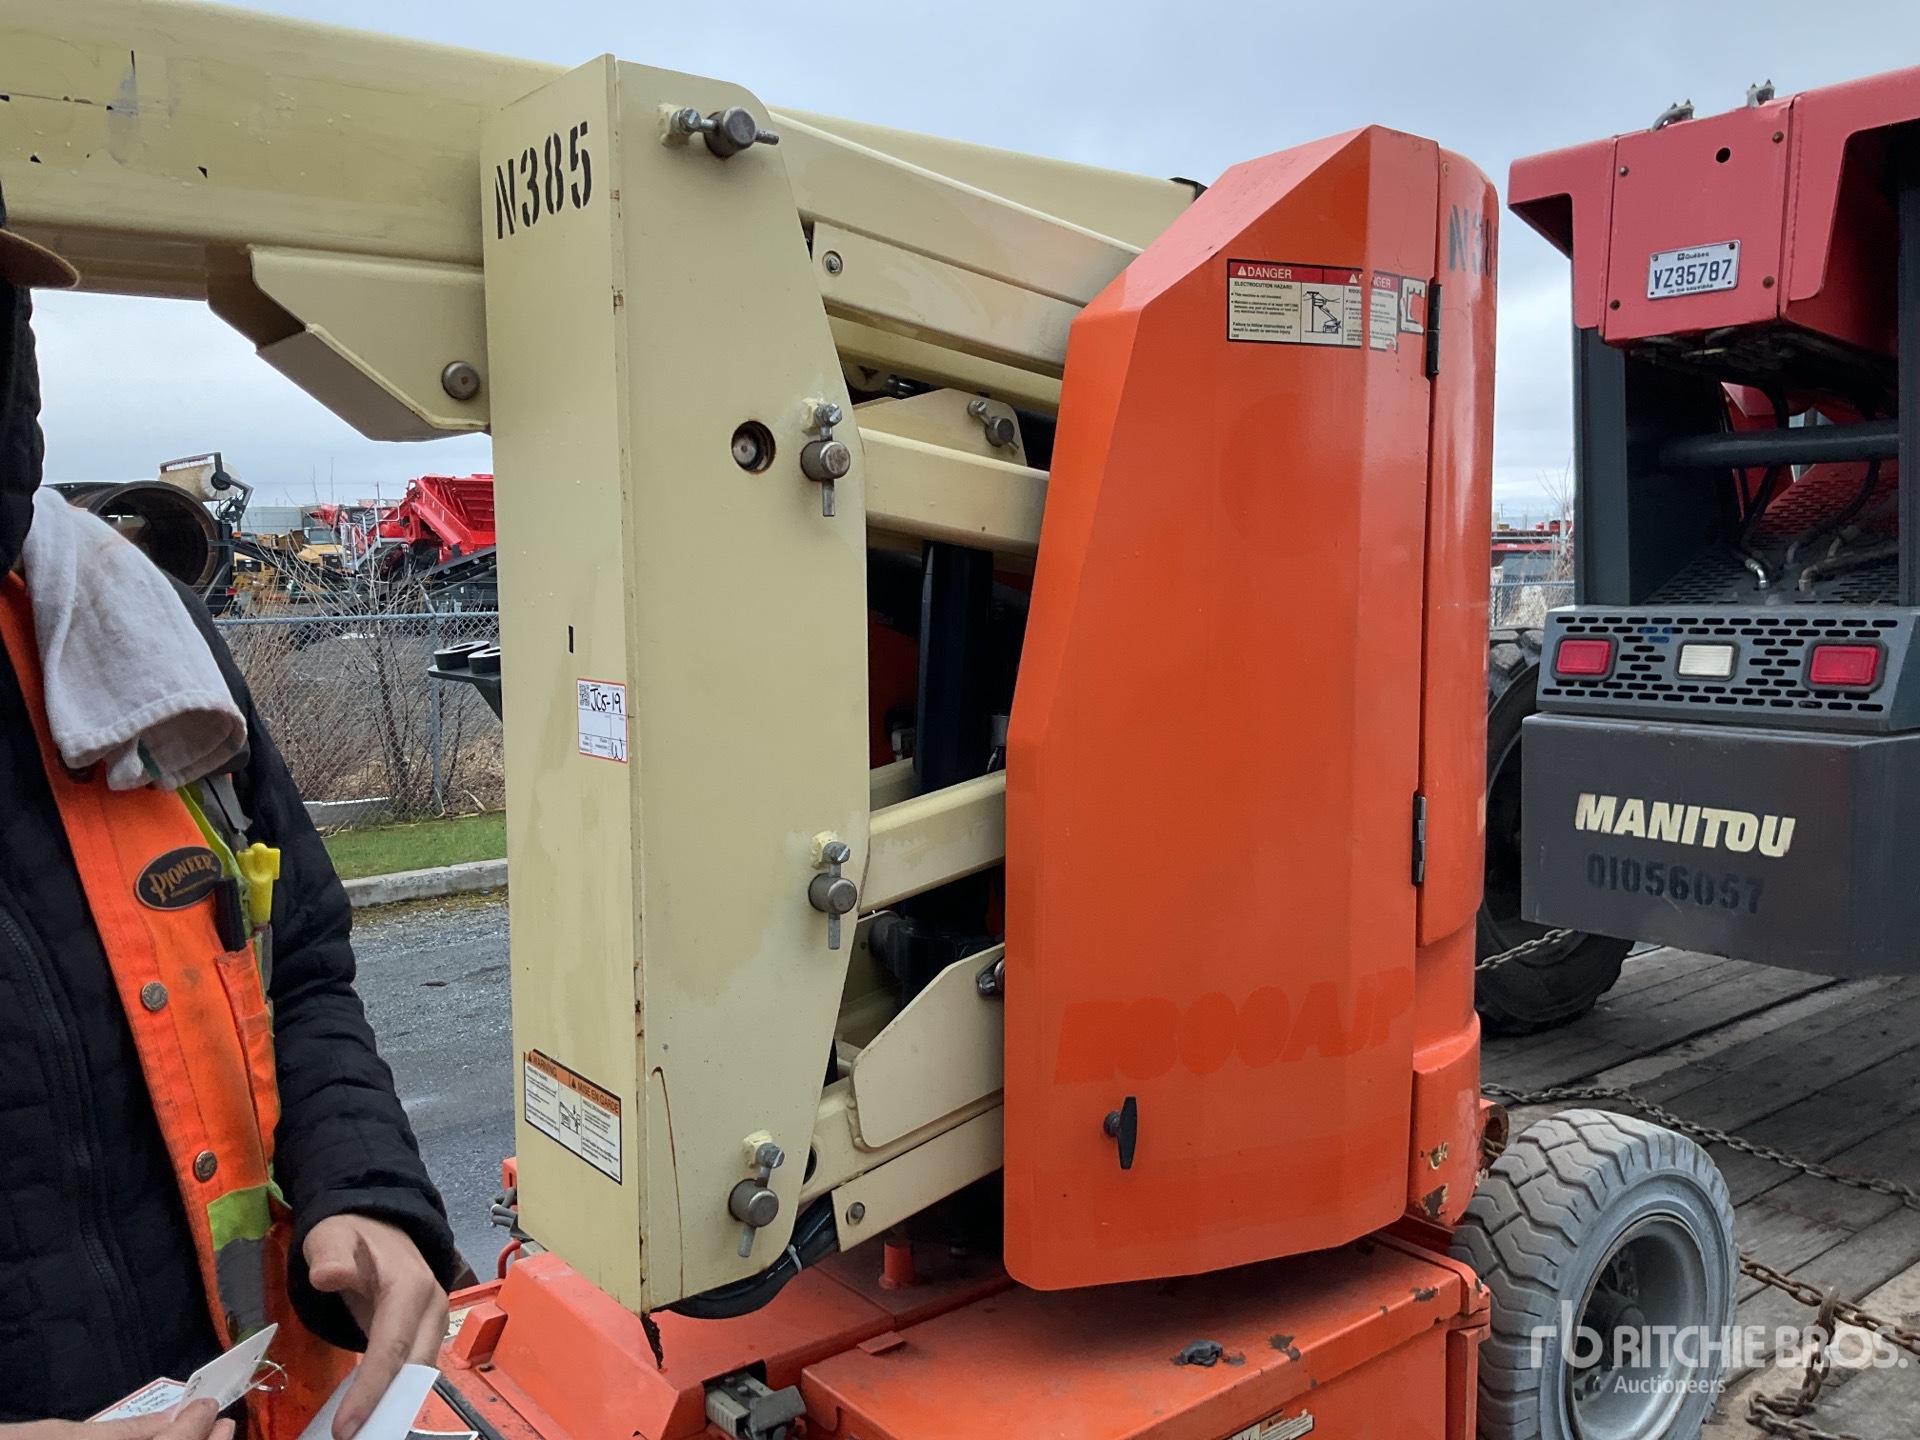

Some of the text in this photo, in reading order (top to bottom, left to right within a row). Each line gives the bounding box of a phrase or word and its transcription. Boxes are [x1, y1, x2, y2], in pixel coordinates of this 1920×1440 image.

[494, 121, 592, 240] N385
[1248, 266, 1292, 279] DANGER
[1654, 259, 1732, 290] VZ35787
[1575, 792, 1796, 858] MANITOU
[148, 854, 217, 904] PIONEER
[533, 1056, 557, 1078] WARNING
[578, 1082, 590, 1097] MISE
[592, 1089, 599, 1102] EN
[600, 1095, 618, 1114] GARDE
